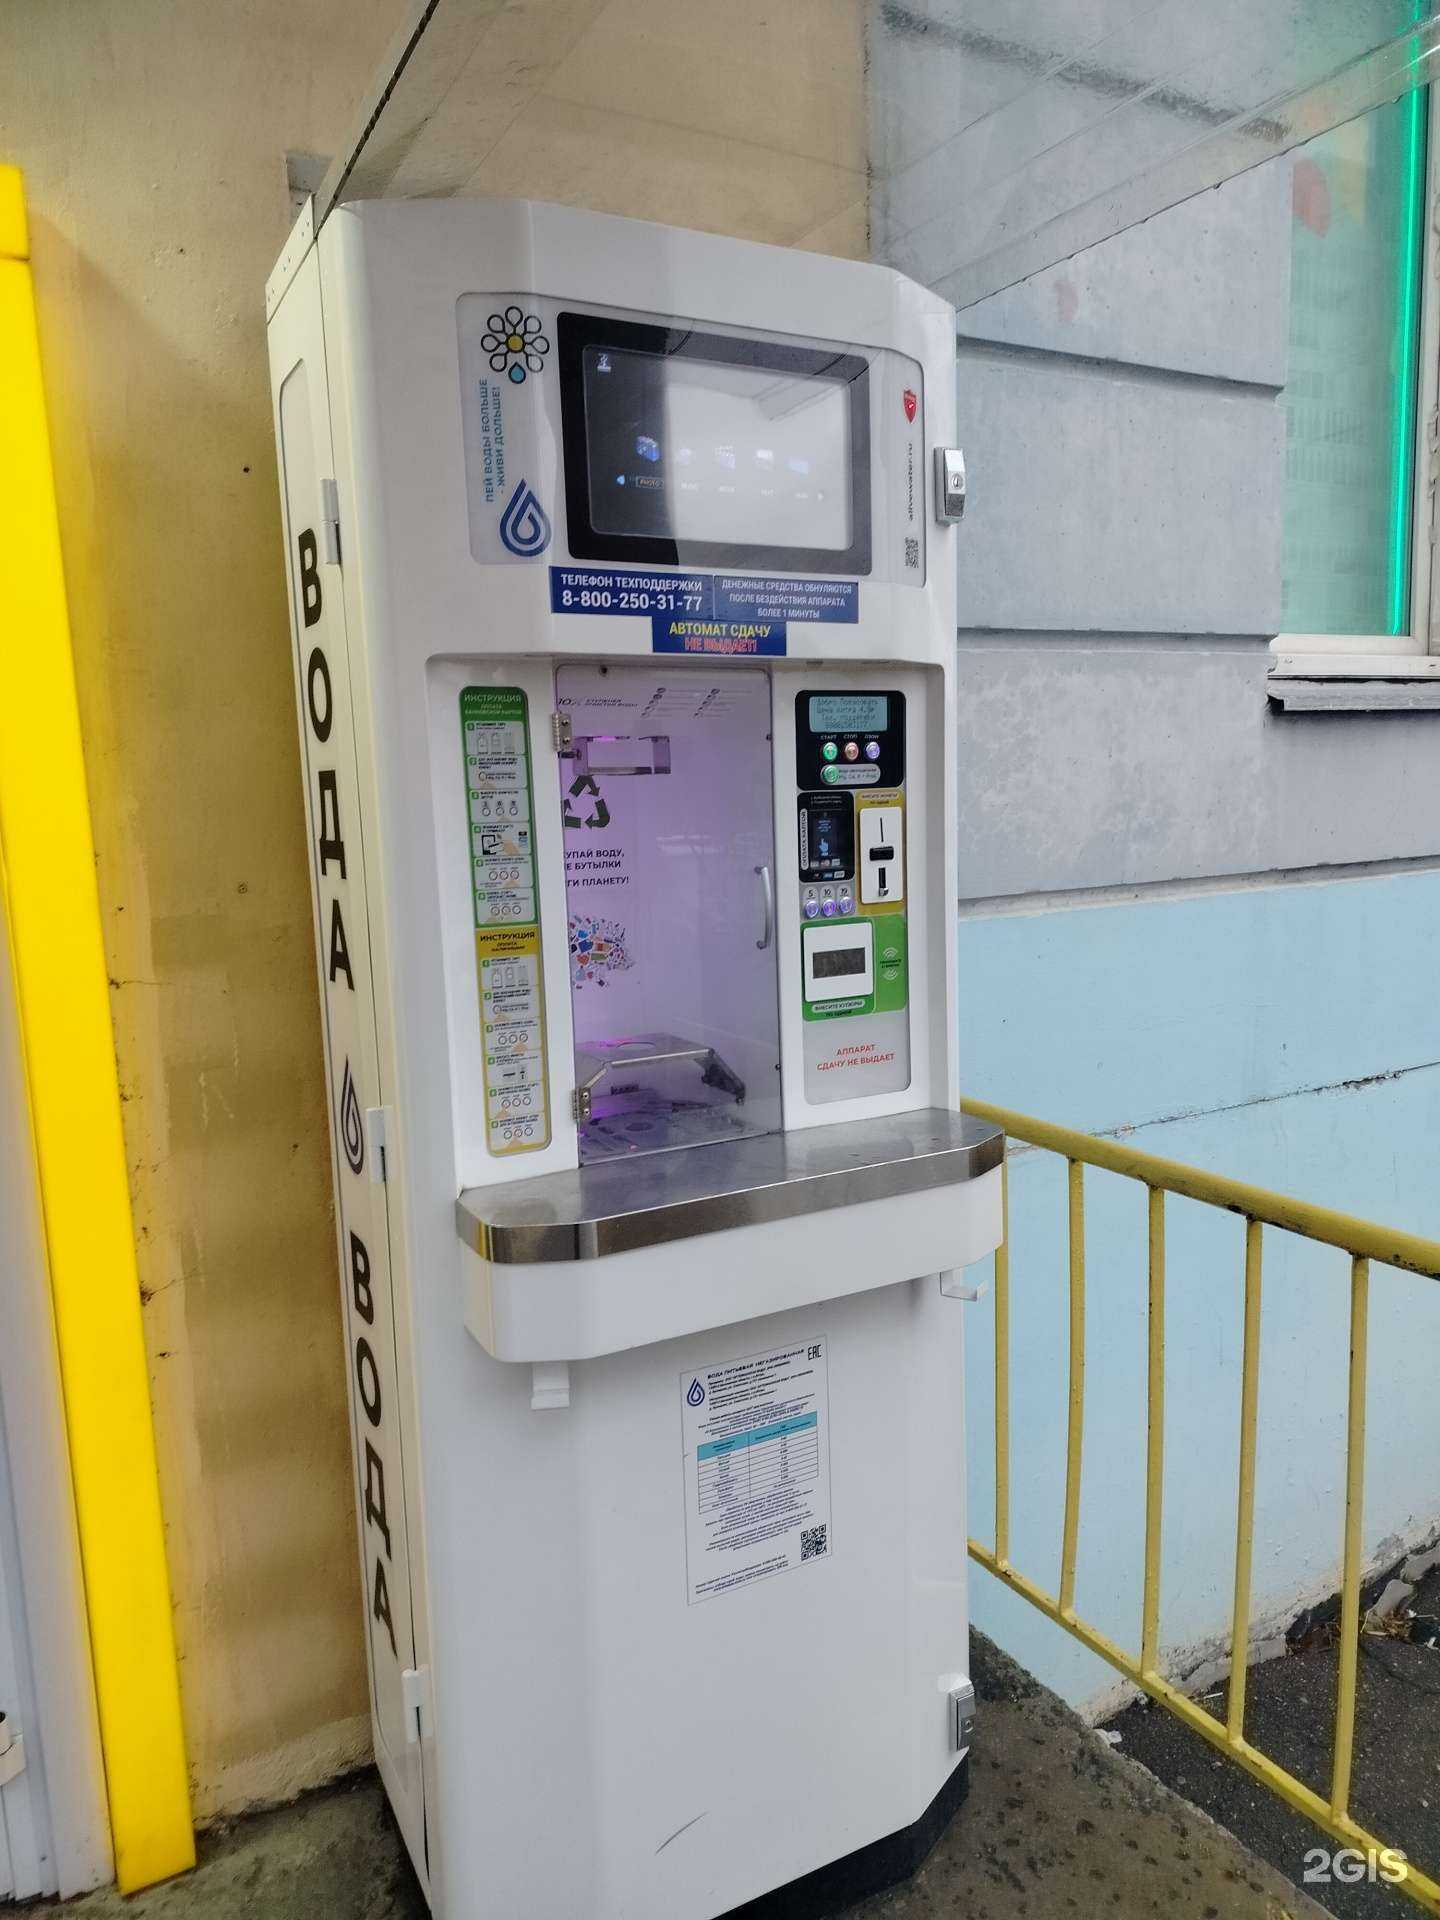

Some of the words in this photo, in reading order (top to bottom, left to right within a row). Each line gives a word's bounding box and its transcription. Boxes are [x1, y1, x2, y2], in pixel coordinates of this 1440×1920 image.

[479, 378, 491, 432] БОЛЬШЕ
[492, 386, 504, 446] ДОЛЬШЕ!
[482, 436, 493, 474] ВОДЫ
[495, 449, 505, 487] ЖИВИ
[484, 477, 494, 503] ПЕЙ
[561, 573, 612, 587] ТЕЛЕФОН
[615, 576, 702, 592] ТЕХПОДДЕРЖКИ
[722, 579, 764, 590] ДЕНЕЖНЫЕ
[766, 581, 803, 593] СРЕДСТВА
[805, 583, 852, 594] ОБНУЛЯЮТСЯ
[562, 590, 702, 612] 8-800-250-31-77
[729, 593, 755, 603] ПОСЛЕ
[756, 595, 807, 605] БЕЗДЕЙСТВИЯ
[808, 597, 845, 606] АППАРАТА
[758, 608, 781, 617] БОЛЕЕ
[783, 609, 787, 617] 1
[788, 609, 820, 618] МИНУТЫ
[669, 622, 727, 636] АВТОМАТ
[730, 624, 771, 638] СДАЧУ
[685, 637, 702, 651] НЕ
[465, 694, 521, 703] ИНСТРУКЦИЯ
[298, 528, 355, 992] ВОДА
[596, 848, 625, 858] ВОДУ,
[575, 860, 621, 870] БУТЫЛКИ
[582, 876, 629, 886] ПЛАНЕТУ!
[480, 931, 535, 941] ИНСТРУКЦИЯ
[836, 1044, 875, 1056] АППАРАТ
[817, 1060, 846, 1071] СДАЧУ
[848, 1057, 859, 1066] НЕ
[860, 1053, 895, 1064] ВЫДАЕТ
[808, 1344, 822, 1360] EAC
[350, 1230, 398, 1659] ВОДА
